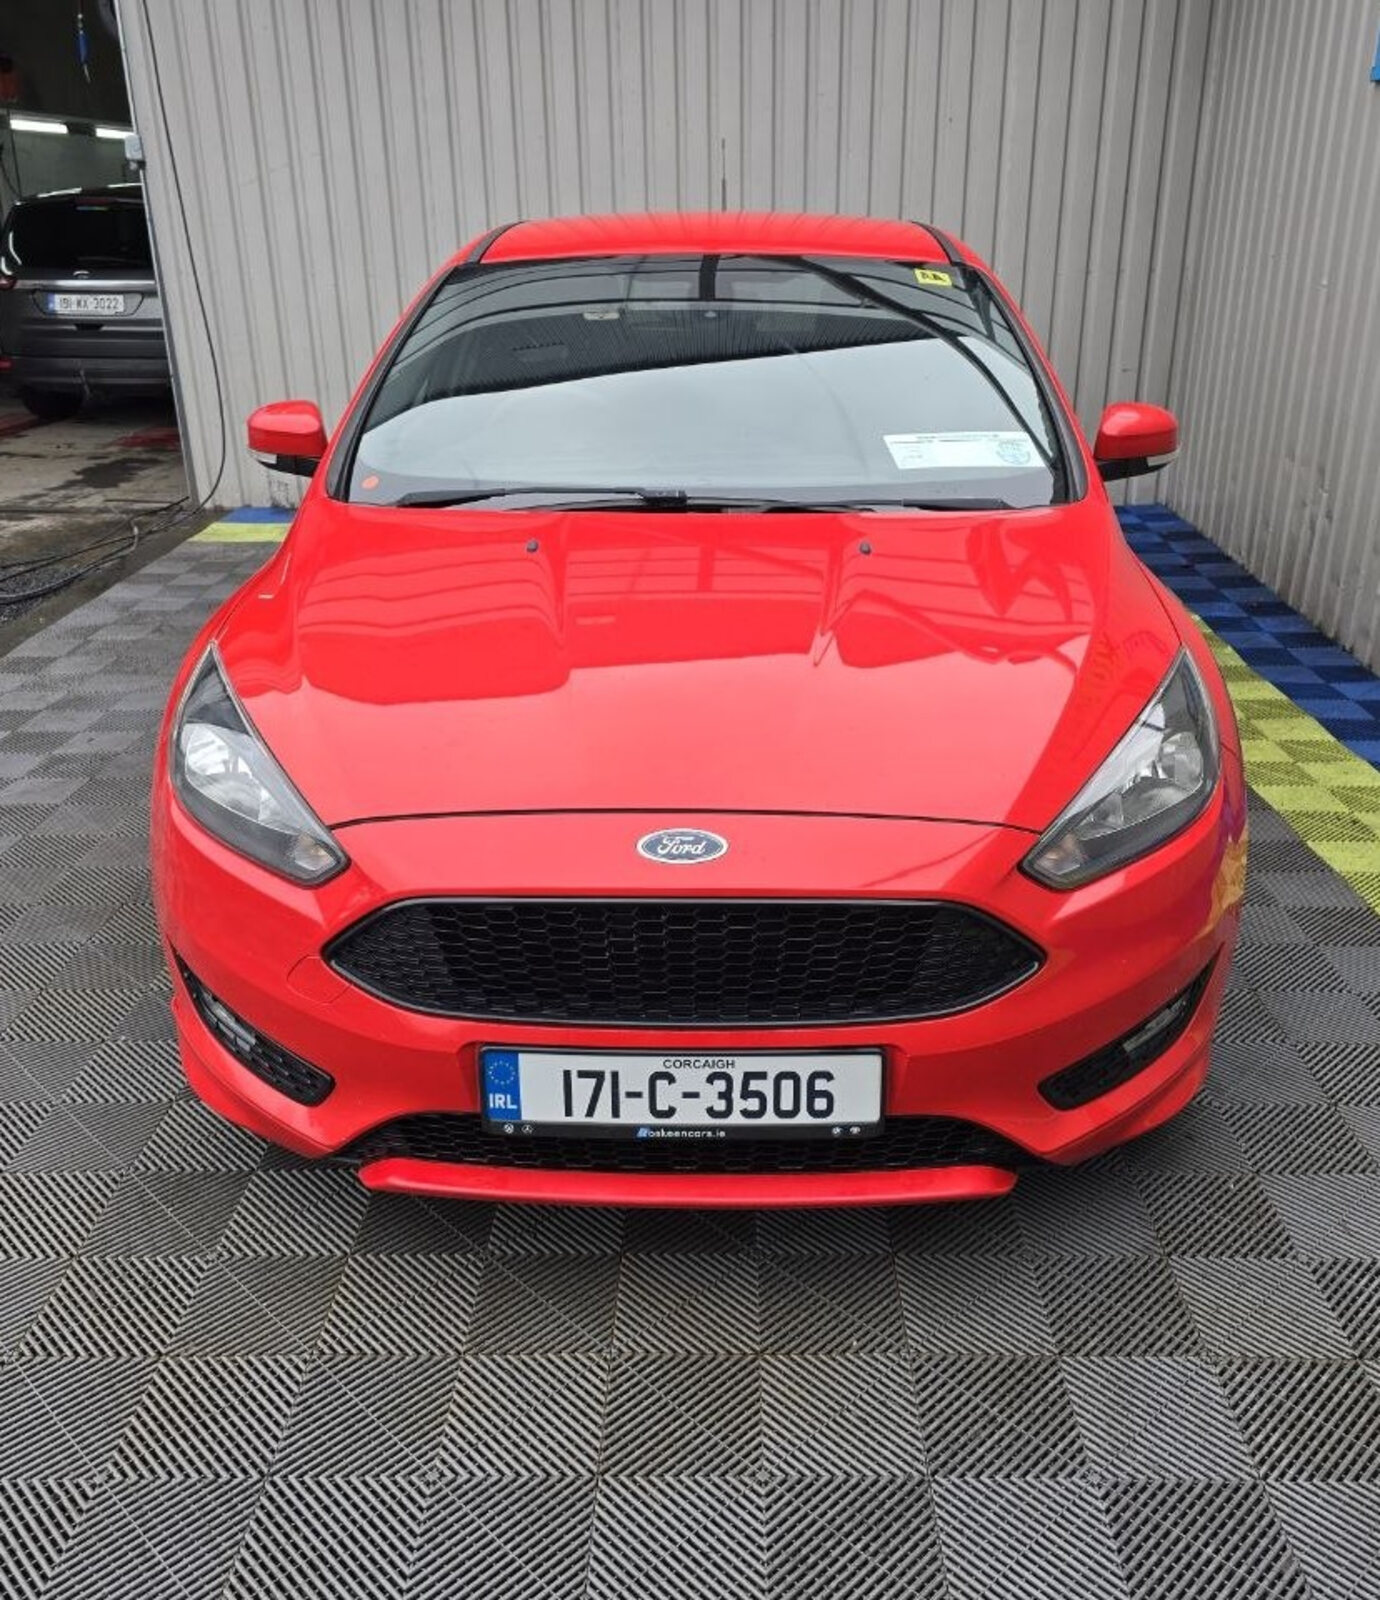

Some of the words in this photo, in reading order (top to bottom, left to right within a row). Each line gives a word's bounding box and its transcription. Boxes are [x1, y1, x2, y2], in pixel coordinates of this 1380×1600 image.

[657, 835, 707, 855] Ford
[662, 1059, 736, 1069] CORCAIGH
[489, 1093, 518, 1110] IRL
[562, 1068, 836, 1120] 171-C-3506
